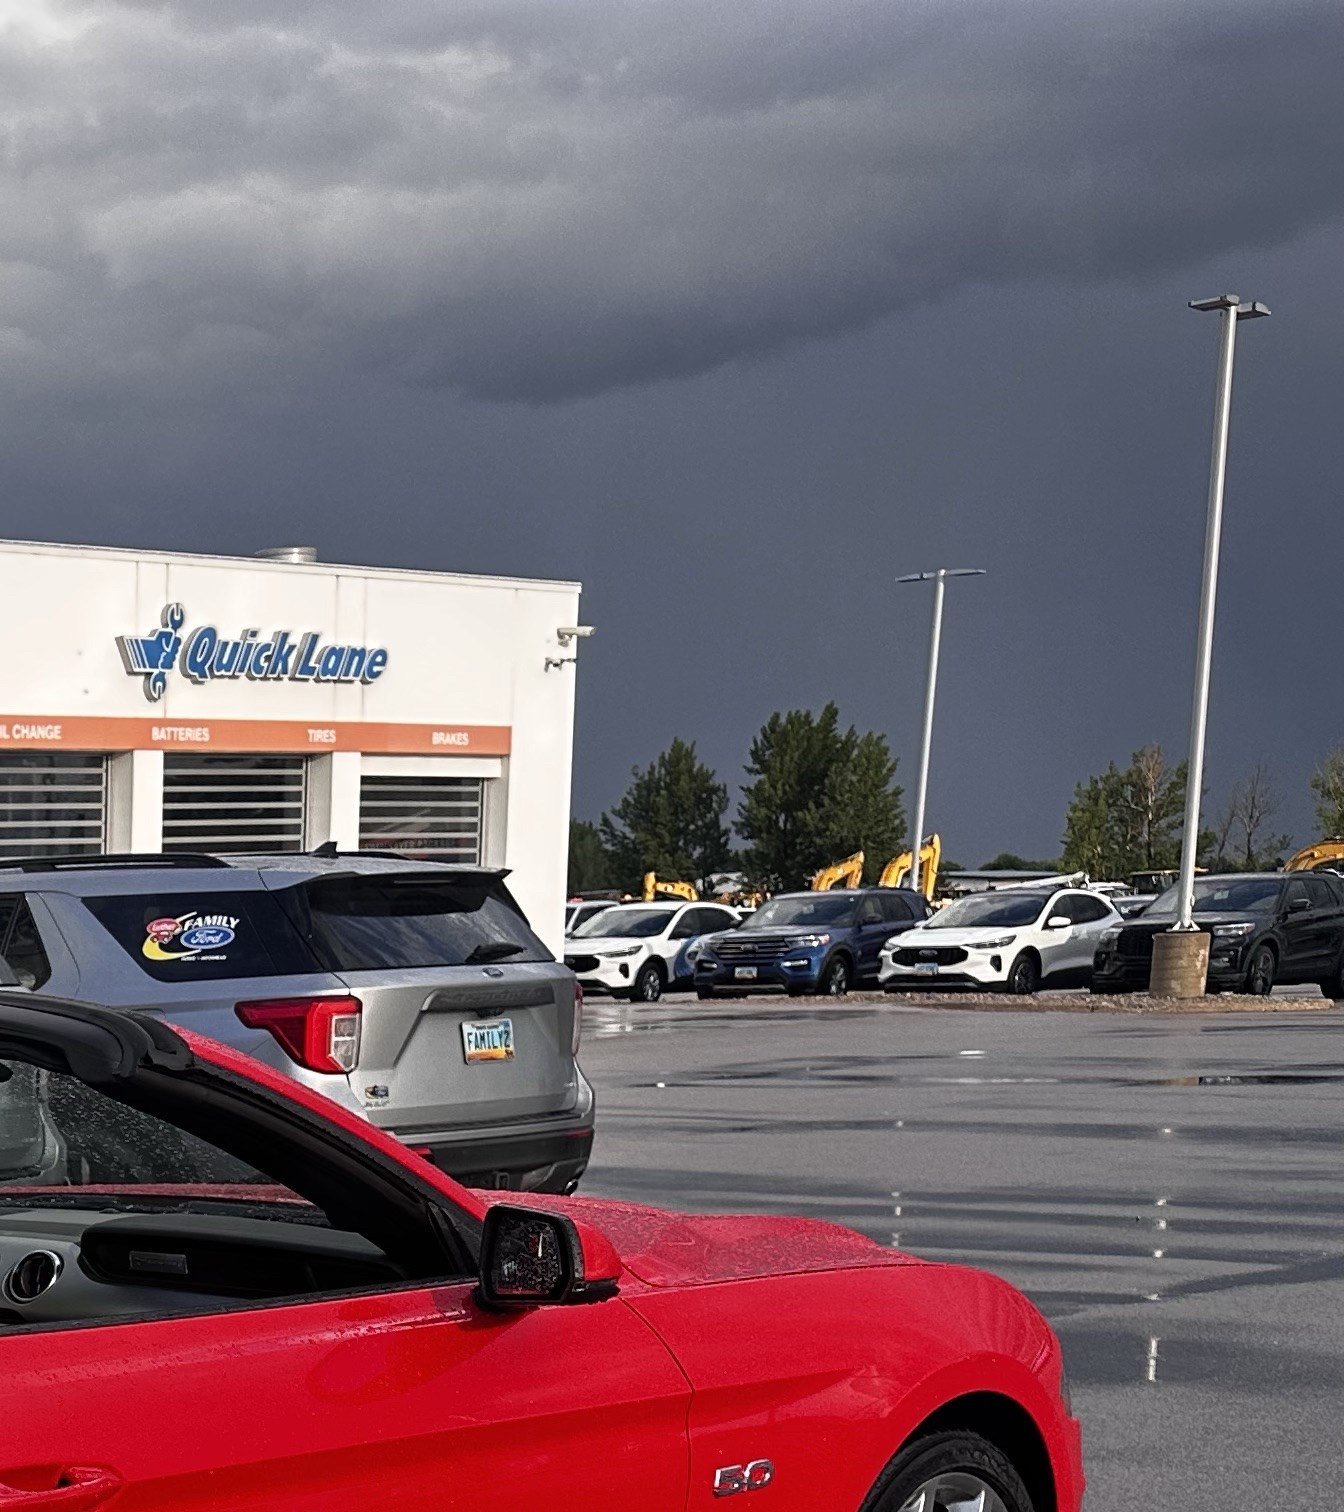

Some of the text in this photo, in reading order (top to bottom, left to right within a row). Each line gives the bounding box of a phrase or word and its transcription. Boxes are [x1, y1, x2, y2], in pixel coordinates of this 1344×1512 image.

[182, 625, 389, 683] Quick Lane
[12, 724, 62, 740] CHANGE
[151, 726, 210, 742] BATTERIES
[307, 729, 337, 743] TIRES
[431, 731, 469, 746] BRAKES
[183, 915, 241, 931] FAMILY
[190, 929, 224, 944] Ford
[466, 1029, 511, 1051] FAMILY2
[712, 1458, 774, 1497] 5.0
